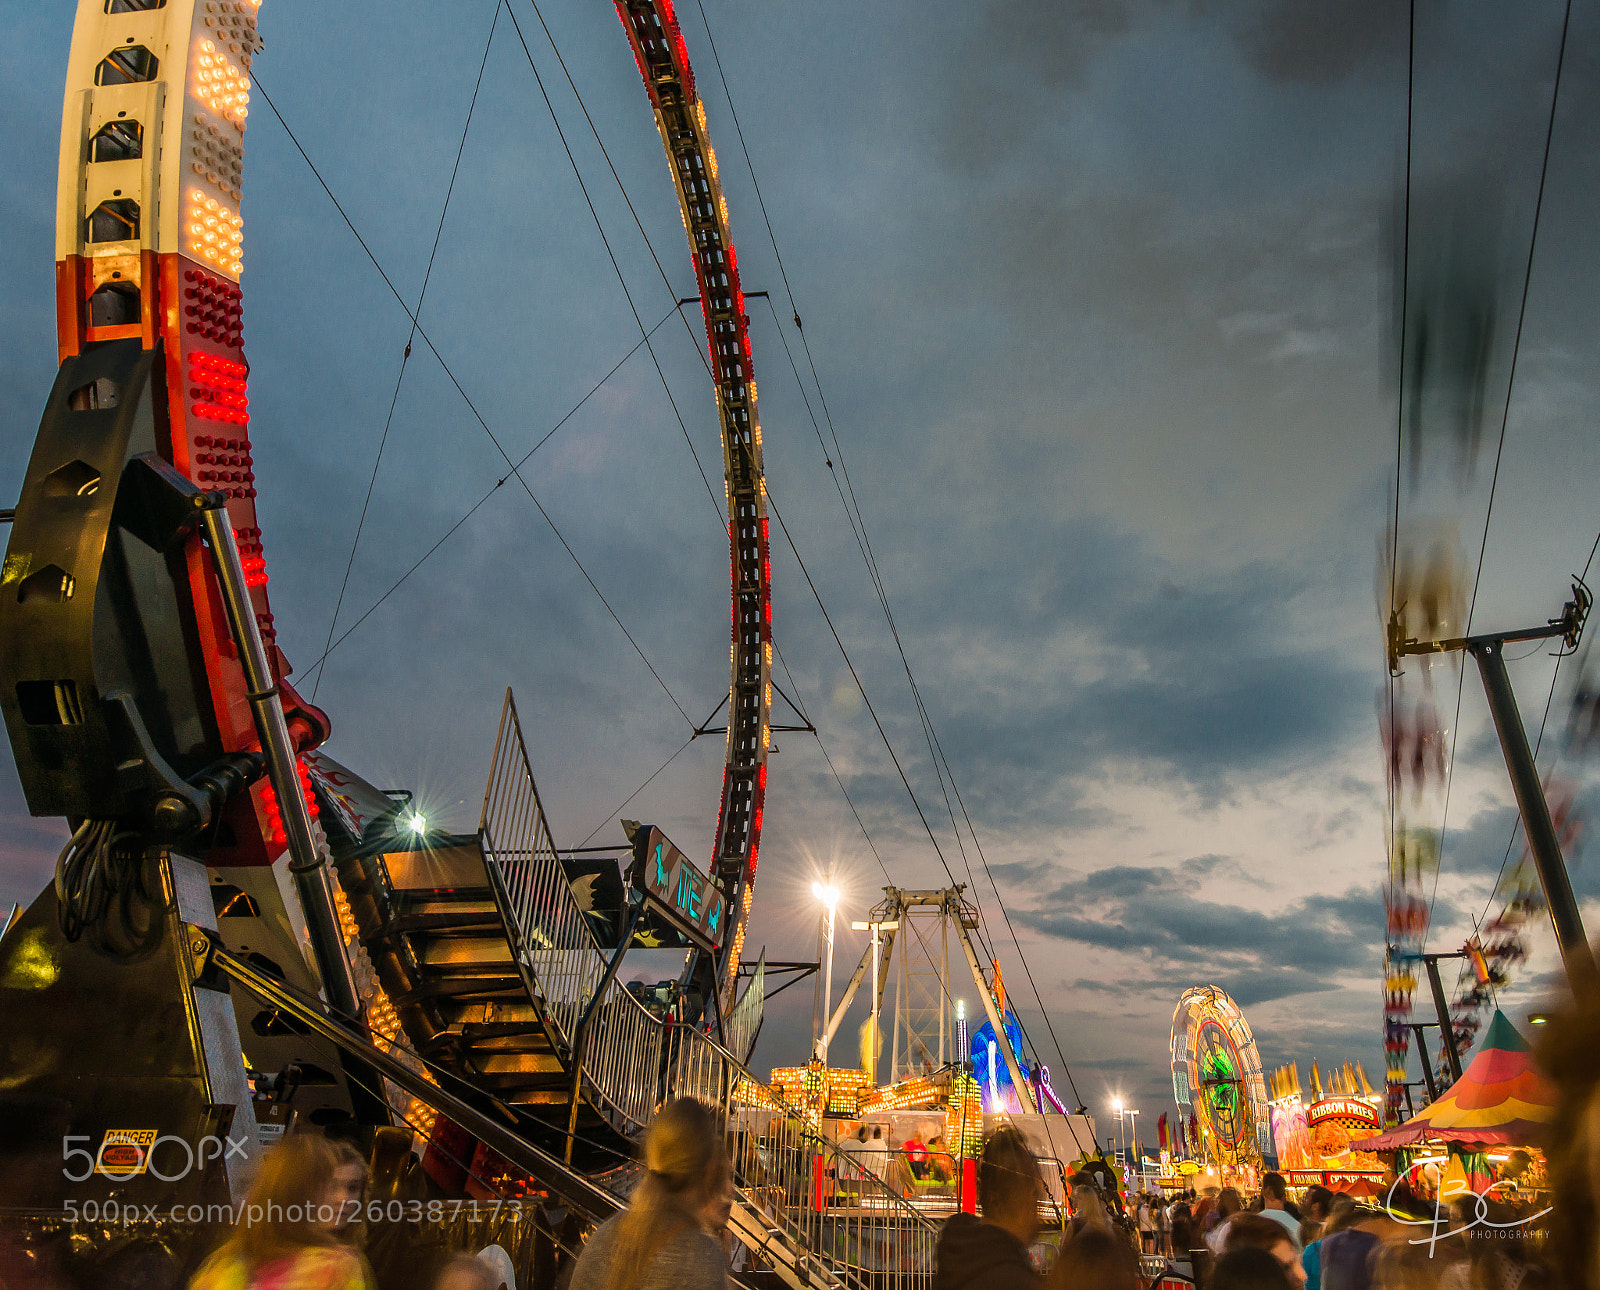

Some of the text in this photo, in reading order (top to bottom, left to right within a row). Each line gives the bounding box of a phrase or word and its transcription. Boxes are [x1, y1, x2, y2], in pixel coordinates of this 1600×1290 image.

[1311, 1102, 1375, 1120] RIBBON FRIES
[106, 1131, 154, 1144] DANGER
[1293, 1174, 1305, 1184] COLD
